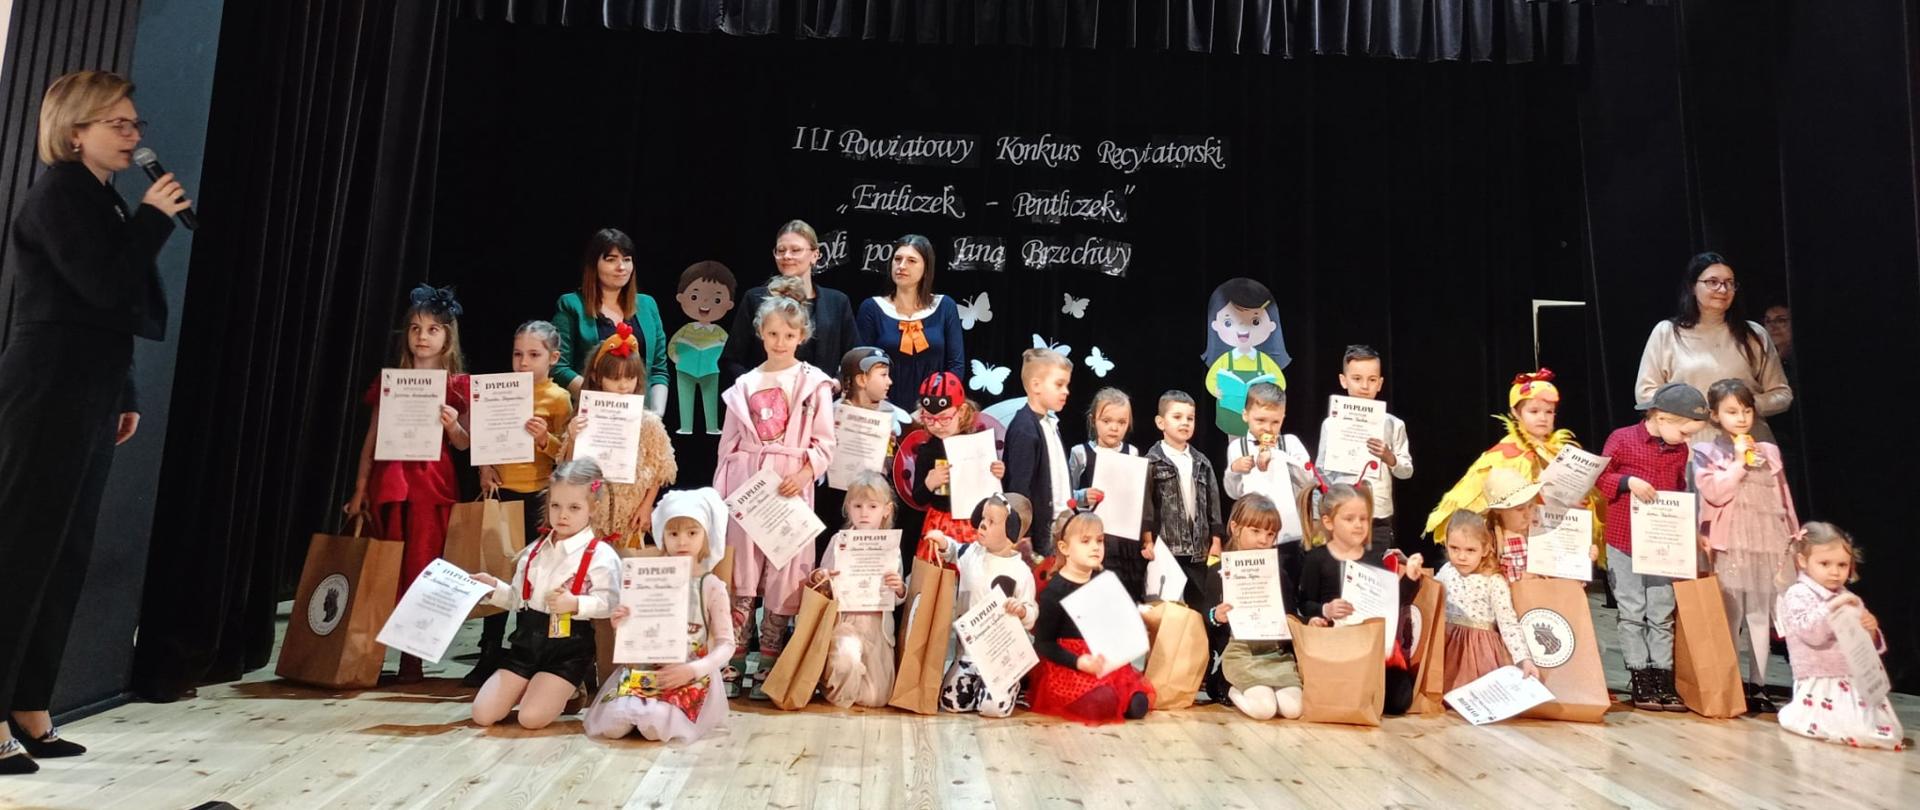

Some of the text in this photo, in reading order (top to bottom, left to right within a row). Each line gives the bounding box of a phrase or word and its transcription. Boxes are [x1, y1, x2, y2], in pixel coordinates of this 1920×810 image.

[792, 126, 1226, 174] III Powiatowy Konkurs Recytatorski
[816, 231, 847, 269] yli
[948, 237, 1006, 271] Jana
[1021, 236, 1132, 275] Brzechwy
[396, 377, 432, 386] DYPLOM
[485, 380, 520, 390] DYPLOM
[594, 399, 629, 409] DYPLOM
[1343, 403, 1374, 413] DYPLOM
[736, 479, 767, 505] DYPLOM
[1545, 512, 1579, 522] DYPLOM
[1234, 558, 1266, 567] DYPLOM
[638, 567, 677, 576] DYPLOM
[970, 600, 998, 627] DYPLOM
